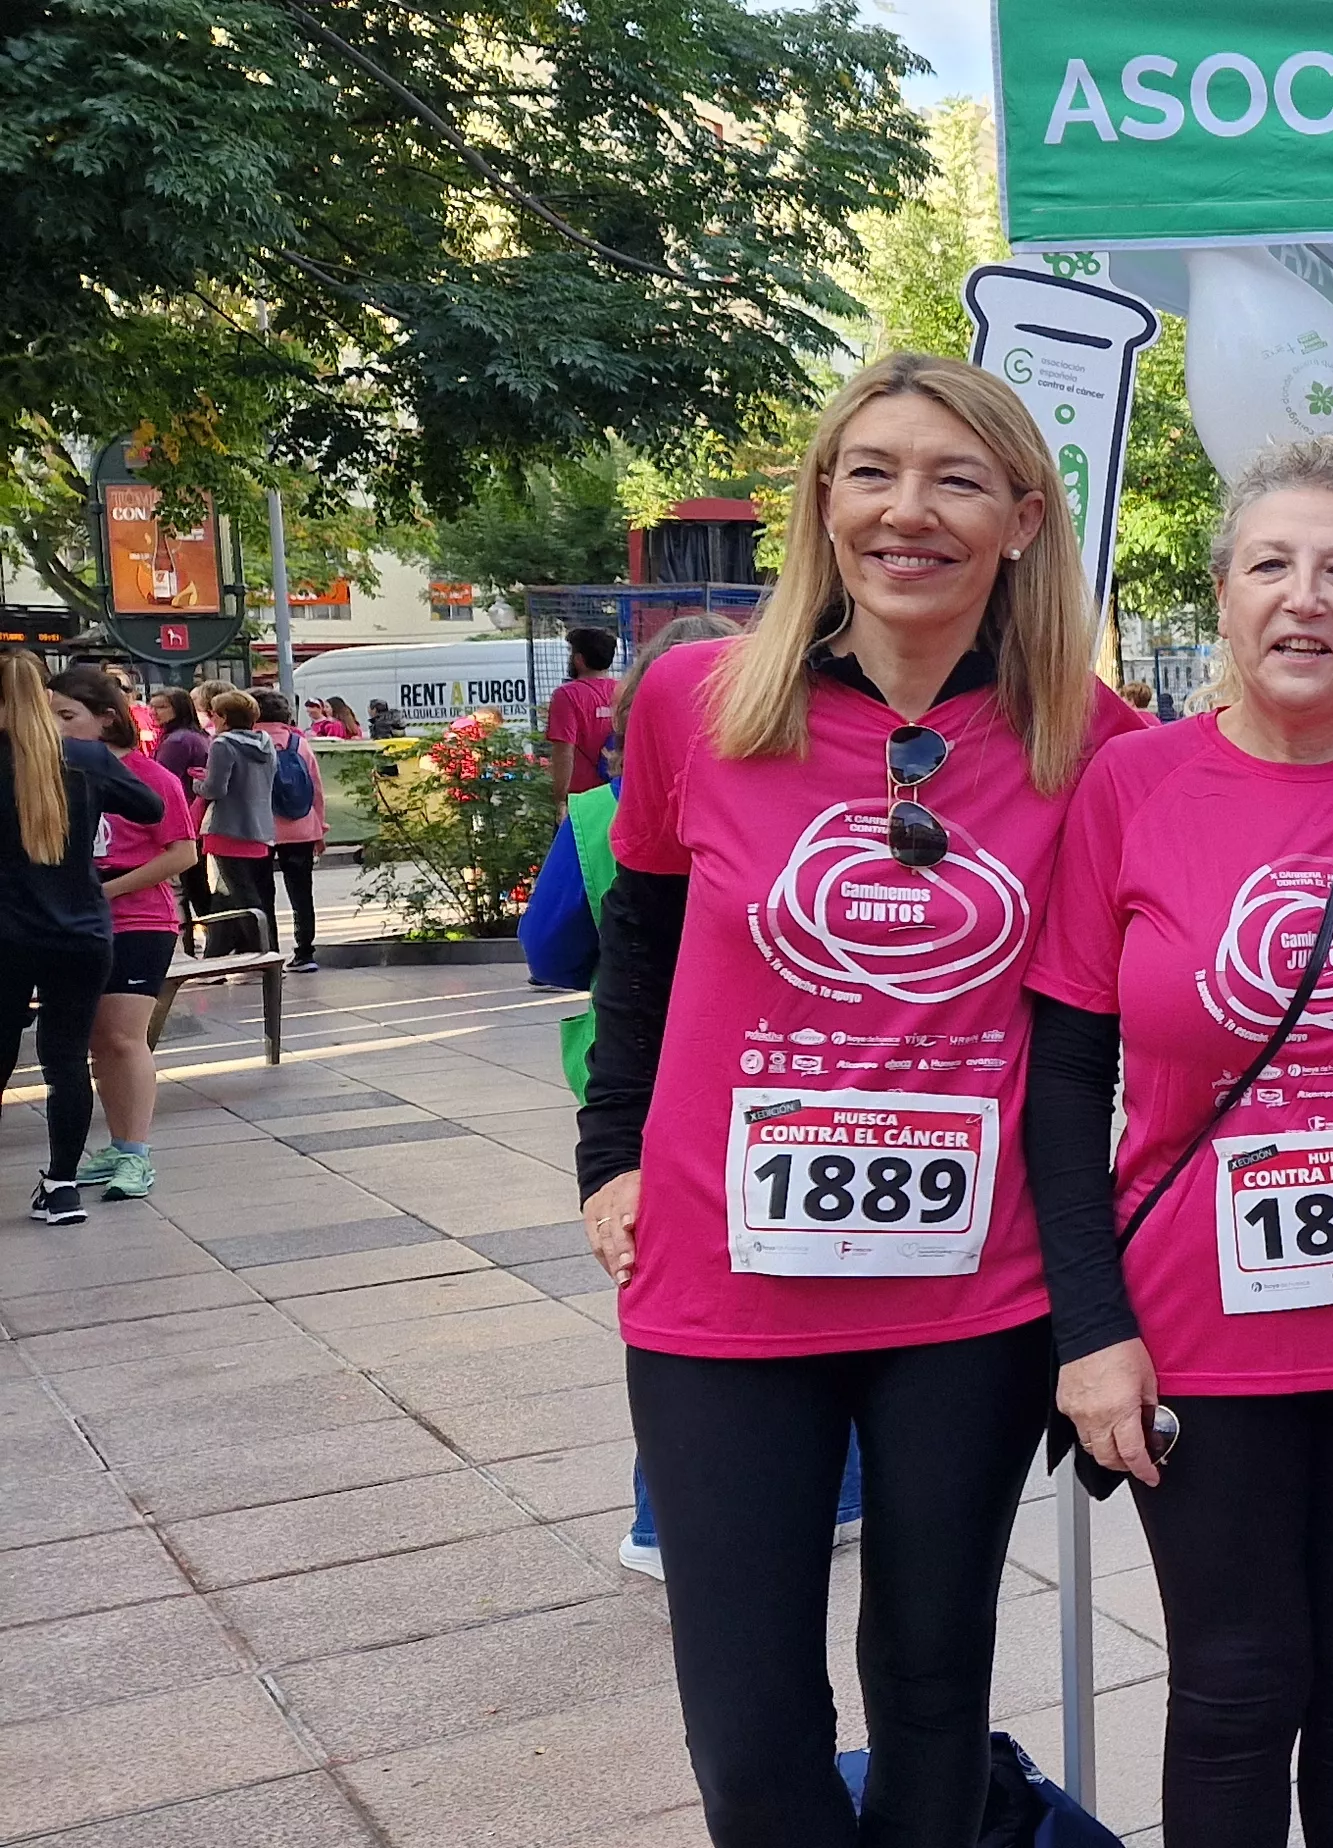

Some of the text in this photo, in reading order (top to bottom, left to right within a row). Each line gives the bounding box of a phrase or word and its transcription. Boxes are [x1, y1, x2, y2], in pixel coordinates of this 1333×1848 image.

[1039, 367, 1078, 382] española
[1041, 357, 1086, 373] asociación
[1037, 379, 1105, 400] contra el cáncer
[400, 679, 526, 707] RENT A FURGO
[401, 706, 447, 719] ALQUILER
[840, 881, 931, 901] Caminemos
[845, 901, 925, 923] JUNTOS
[833, 1111, 898, 1126] HUESCA
[760, 1125, 969, 1148] CONTRA EL CÁNCER
[1243, 1167, 1325, 1188] CONTRA
[754, 1154, 967, 1224] 1889
